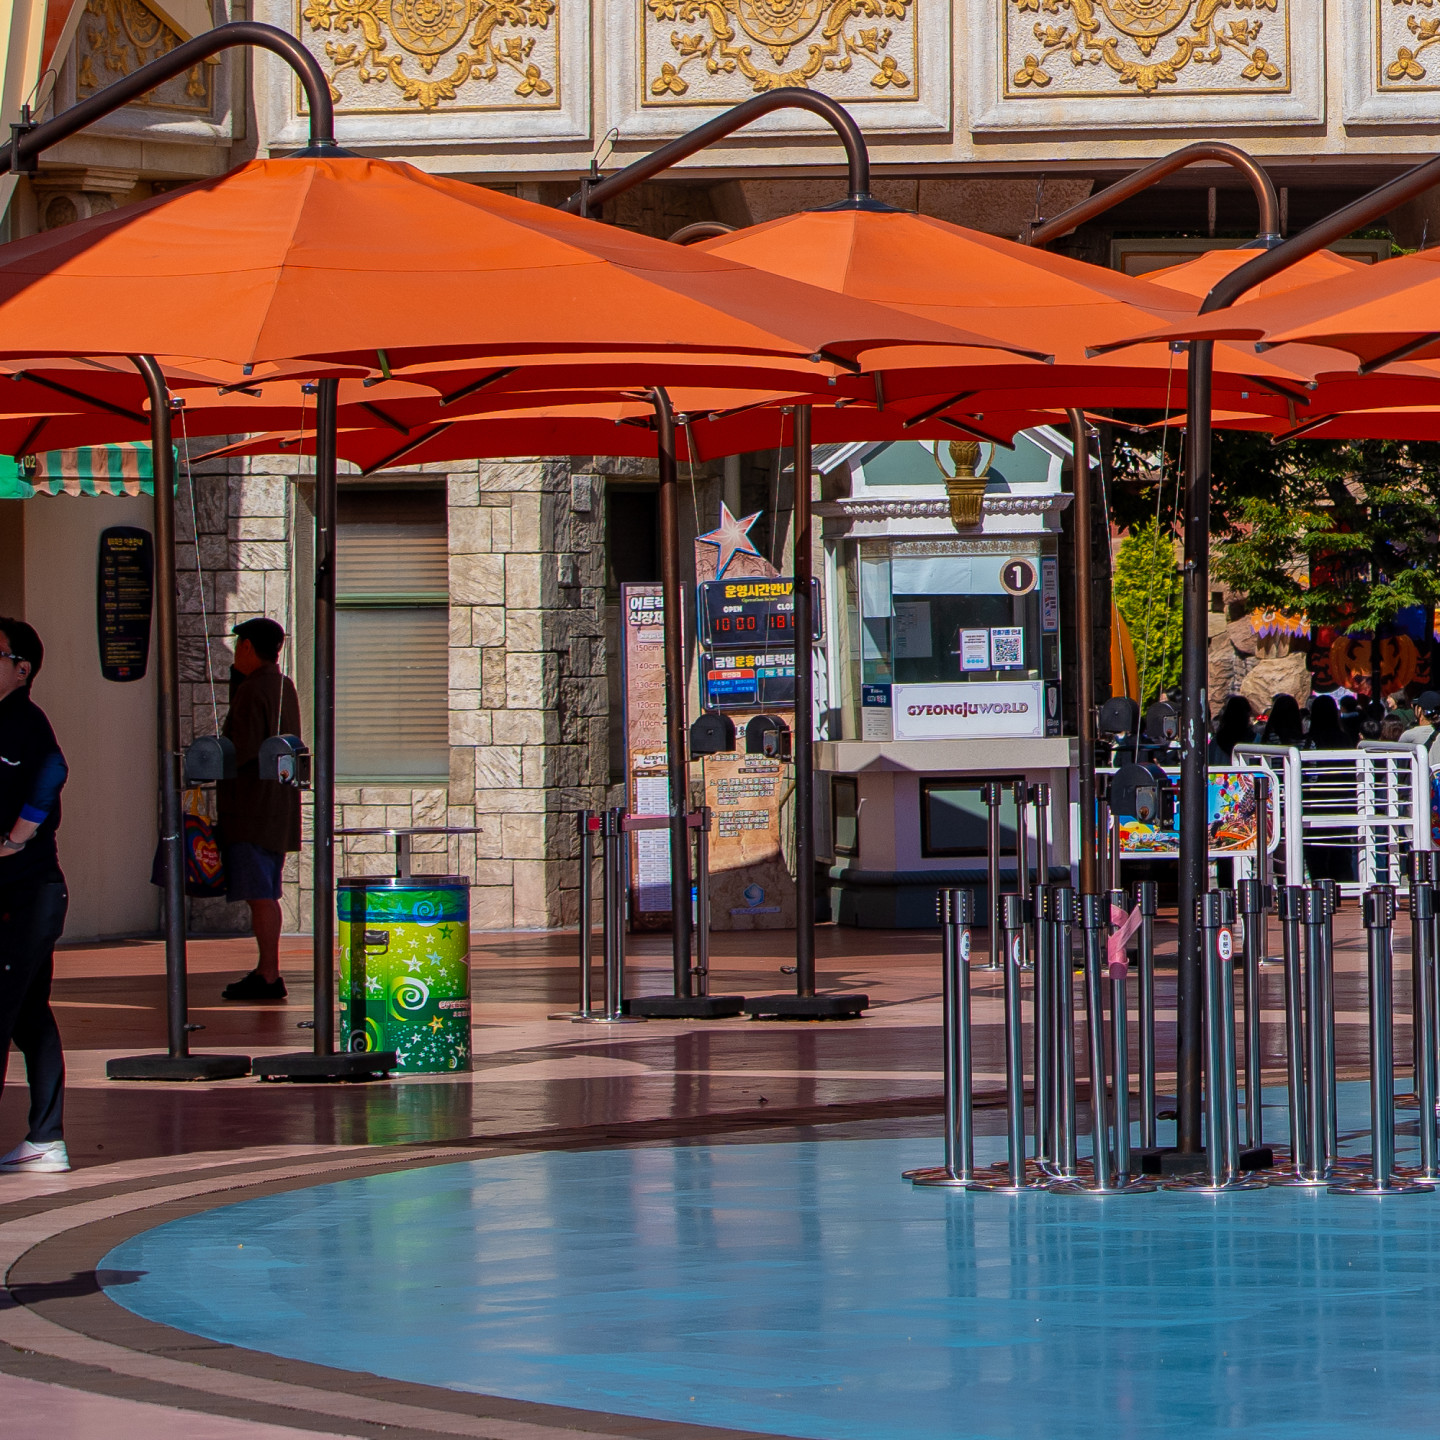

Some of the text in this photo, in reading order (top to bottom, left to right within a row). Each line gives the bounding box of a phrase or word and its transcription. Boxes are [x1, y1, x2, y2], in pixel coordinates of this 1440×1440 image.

[24, 454, 36, 469] 02
[722, 605, 743, 613] OPEN
[635, 662, 660, 670] 140cm
[636, 701, 660, 709] 120cm
